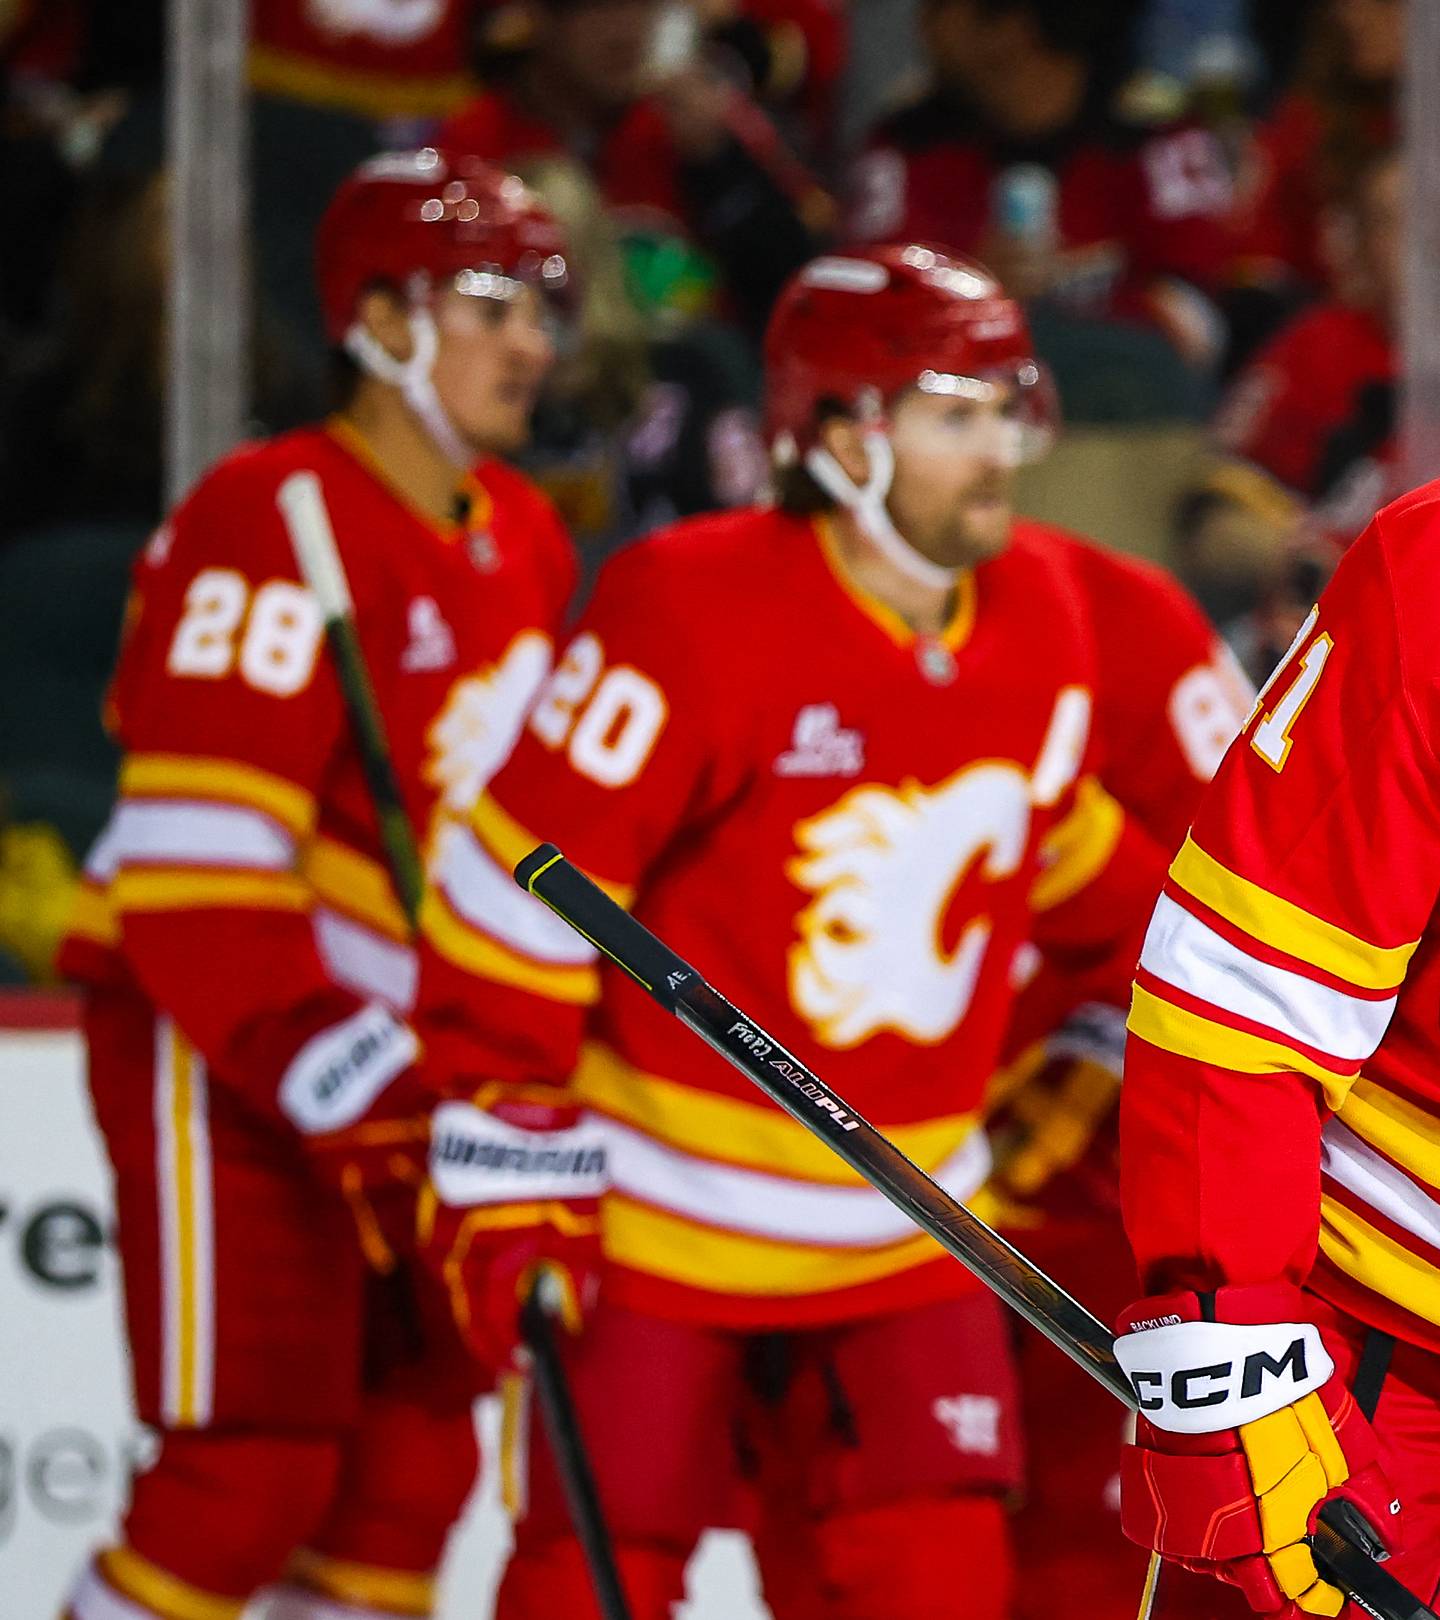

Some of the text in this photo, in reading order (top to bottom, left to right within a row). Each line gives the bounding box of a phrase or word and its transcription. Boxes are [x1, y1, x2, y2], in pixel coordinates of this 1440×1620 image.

[166, 566, 327, 698] 28
[529, 630, 670, 790] 20
[0, 1199, 104, 1292] e
[1129, 1313, 1182, 1334] BACKLUND
[1130, 1337, 1309, 1411] CCM
